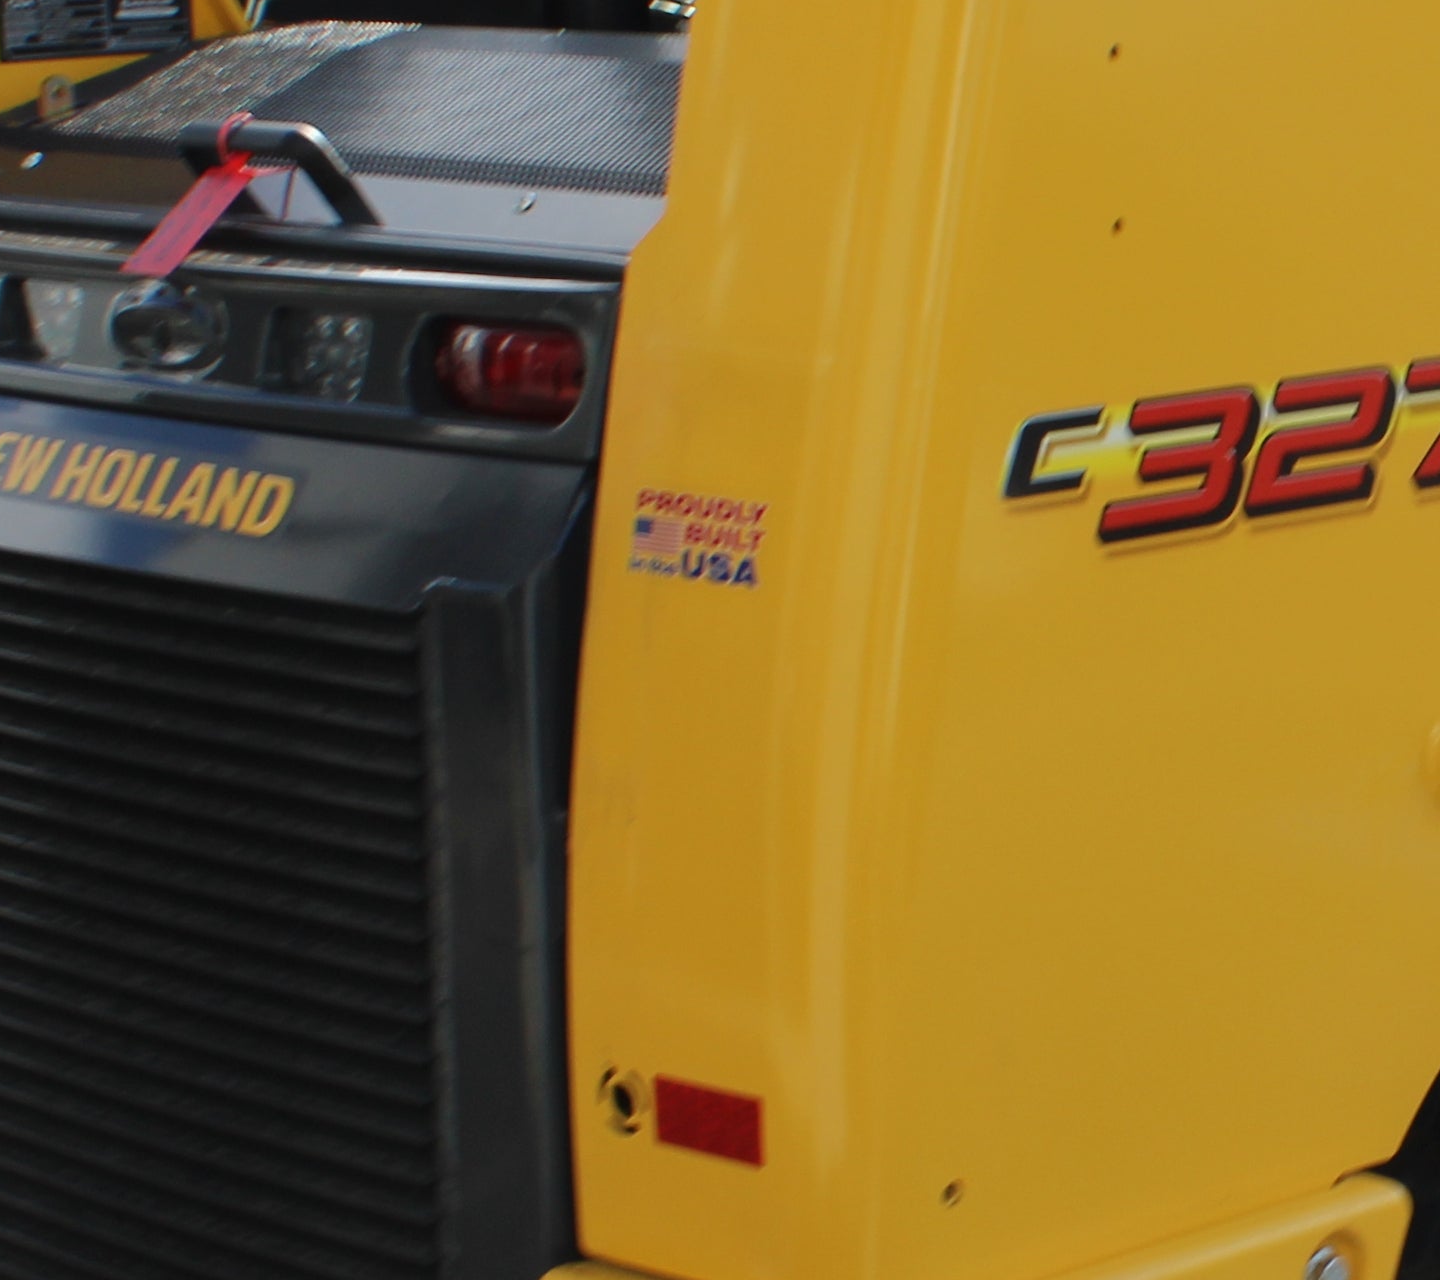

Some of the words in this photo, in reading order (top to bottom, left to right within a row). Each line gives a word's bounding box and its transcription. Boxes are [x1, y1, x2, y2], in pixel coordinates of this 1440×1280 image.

[48, 442, 296, 538] HOLLAND
[636, 488, 769, 525] PROUDLY
[684, 522, 767, 553] BUILT
[680, 549, 758, 585] USA
